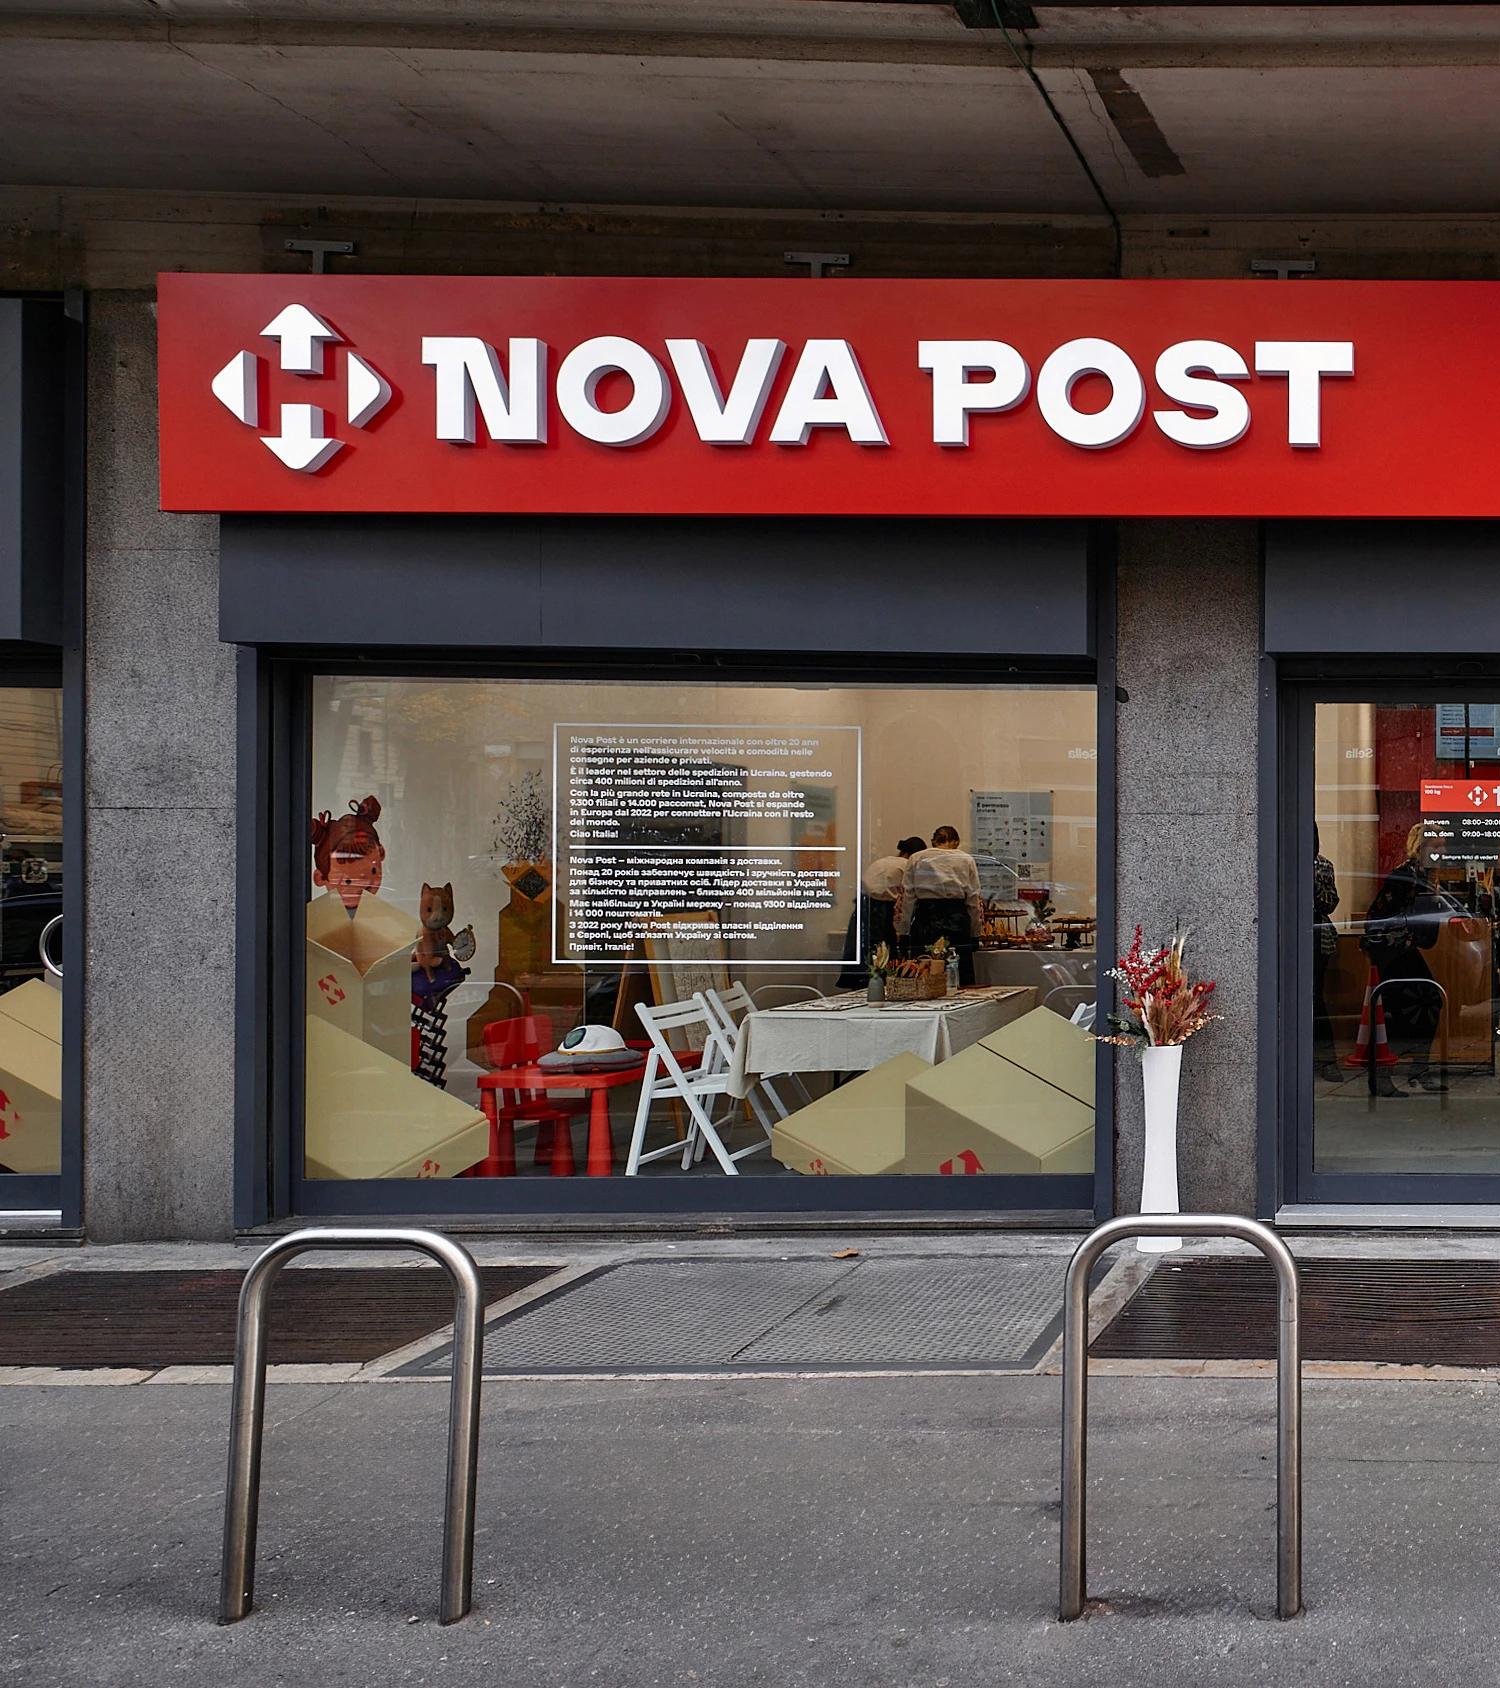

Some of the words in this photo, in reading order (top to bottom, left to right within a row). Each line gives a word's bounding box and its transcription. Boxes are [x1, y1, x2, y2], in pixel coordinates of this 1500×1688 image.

[422, 336, 891, 447] NOVA
[918, 338, 1355, 449] POST
[680, 737, 744, 745] internazionale
[580, 746, 631, 755] esperienza
[679, 757, 712, 765] privati.
[692, 769, 738, 777] spedizioni
[750, 769, 788, 777] Ucraina,
[790, 770, 832, 778] gestendo
[658, 778, 704, 787] spedizioni
[600, 789, 615, 798] più
[616, 790, 650, 798] grande
[683, 790, 720, 798] Ucraina,
[722, 790, 767, 799] composta
[766, 800, 805, 809] espande
[581, 808, 613, 817] Europa
